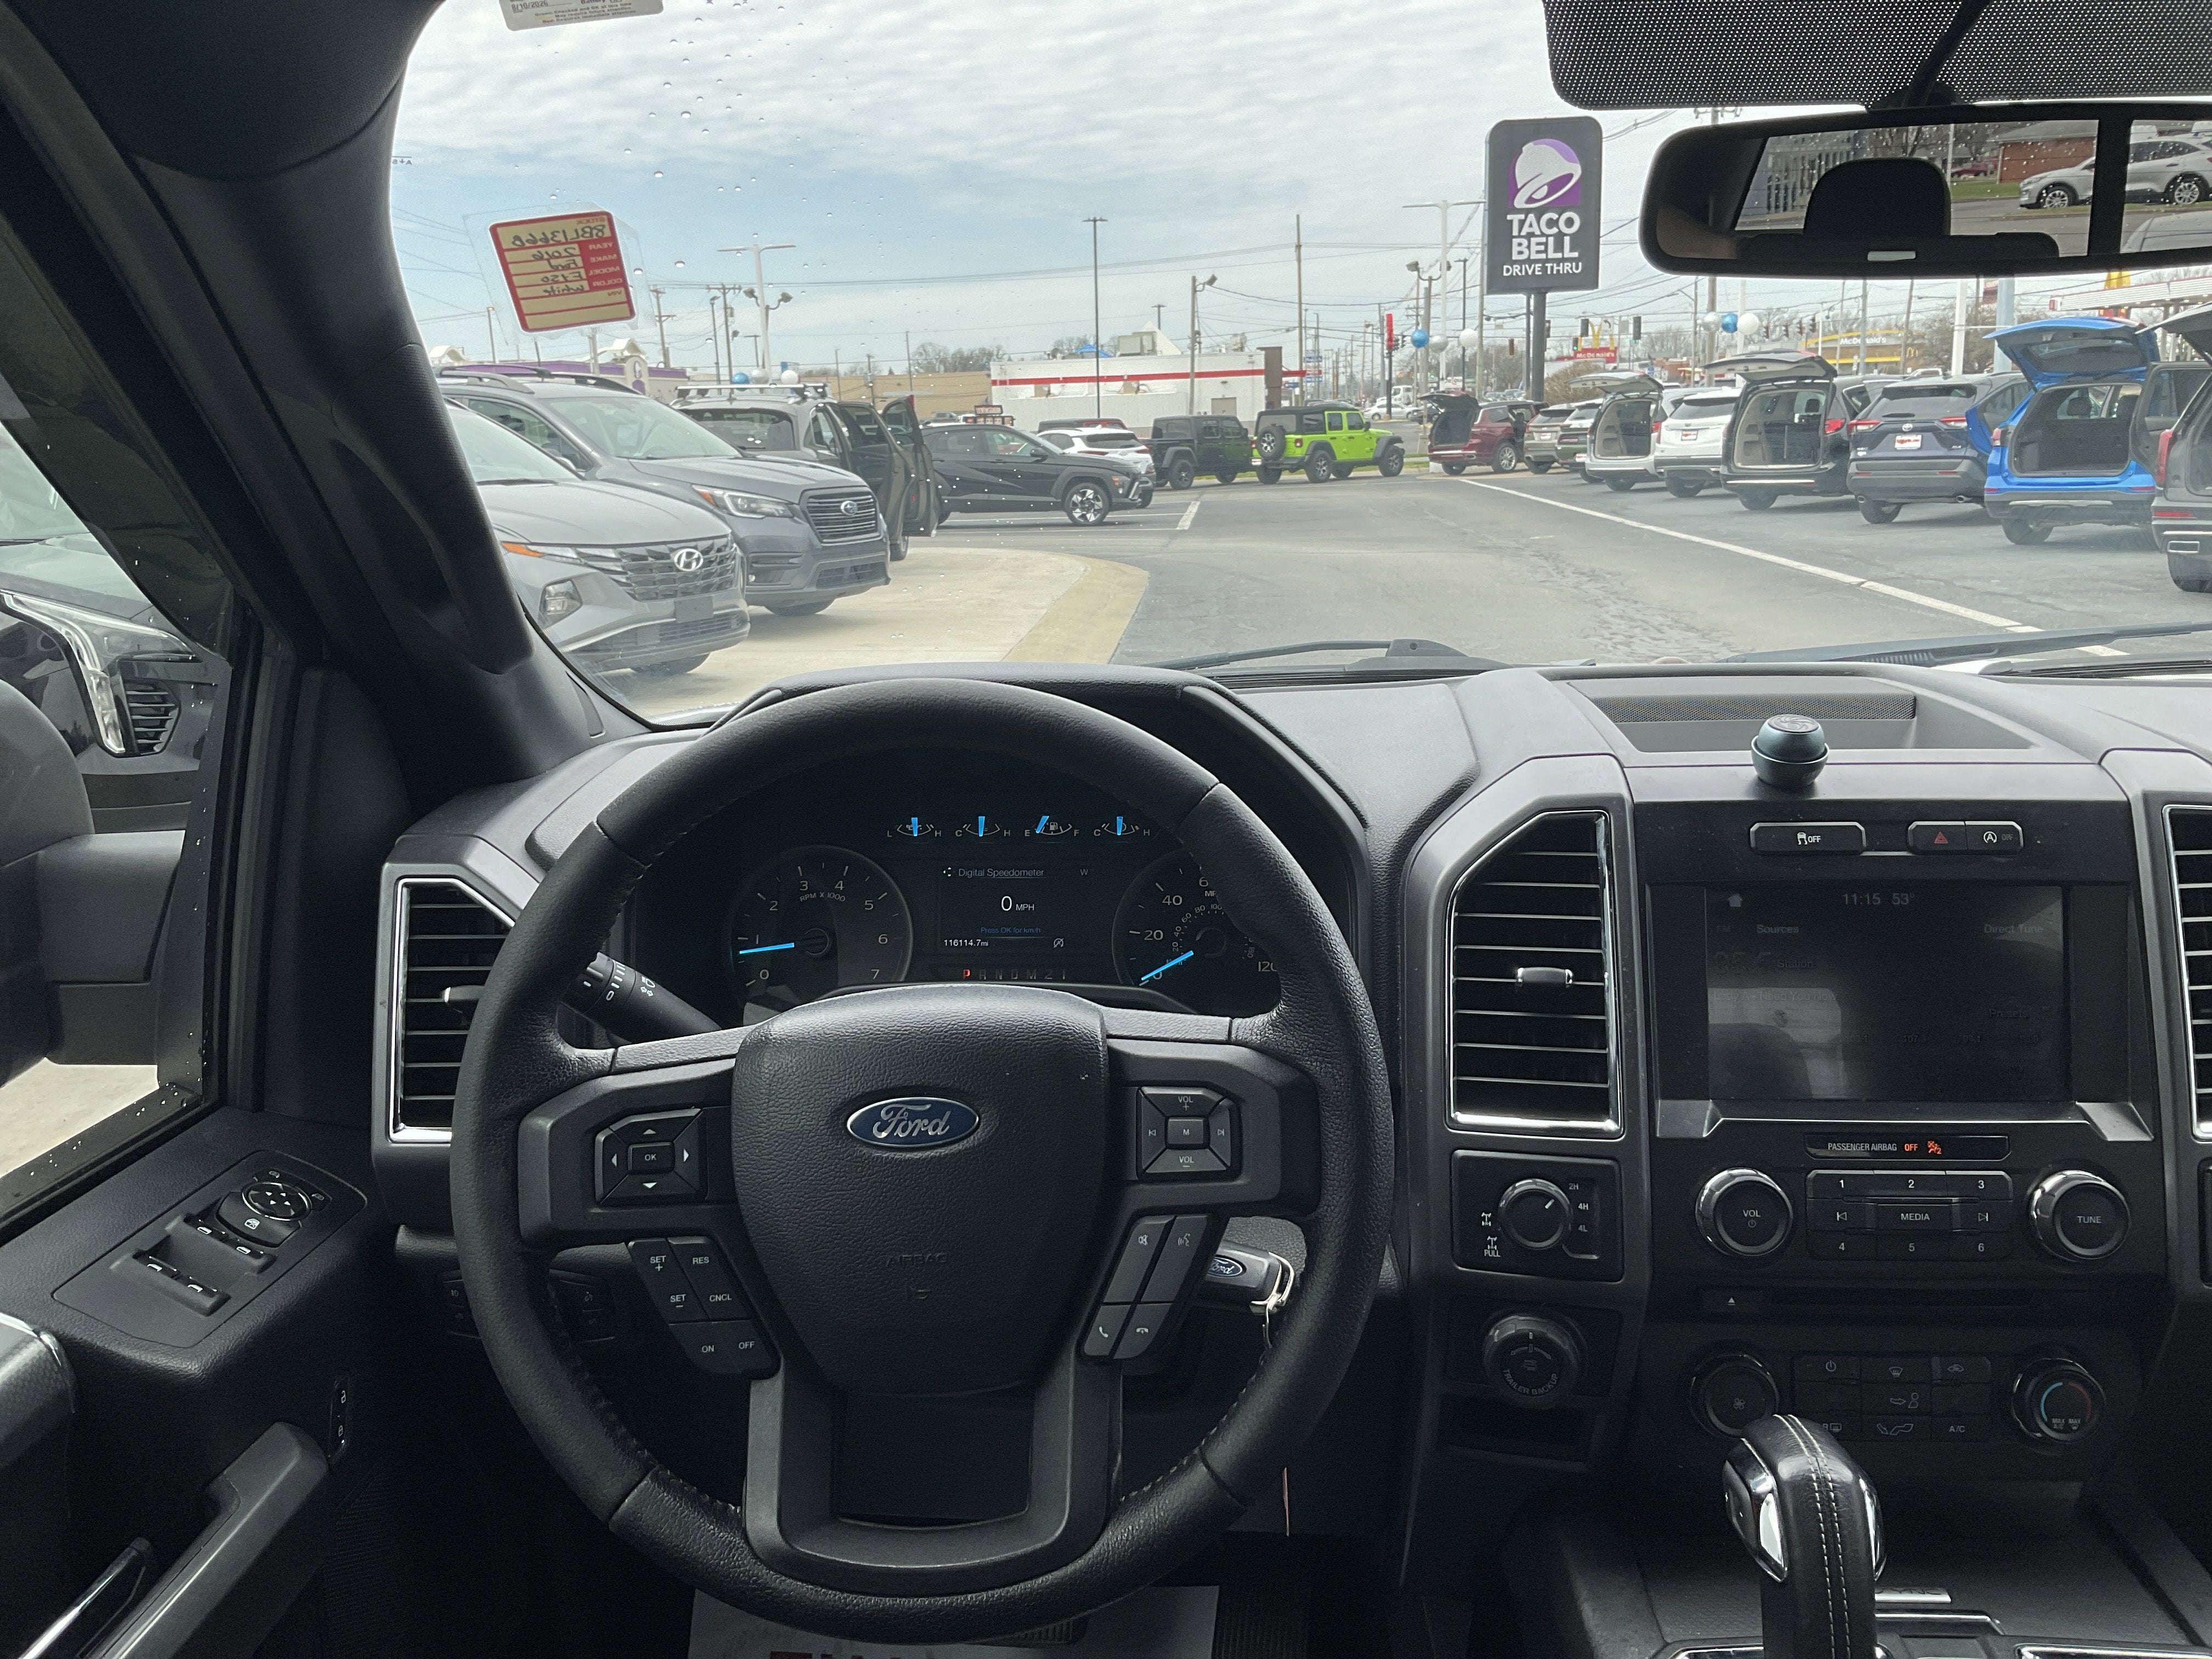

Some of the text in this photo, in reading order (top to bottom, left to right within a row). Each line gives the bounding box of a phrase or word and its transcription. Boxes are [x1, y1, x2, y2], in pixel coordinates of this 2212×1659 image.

[512, 1, 548, 10] 8/10/2026
[1506, 212, 1581, 236] TACO
[1512, 236, 1579, 261] BELL
[1503, 262, 1582, 276] DRIVE THRU
[1808, 835, 1821, 843] OFF
[958, 868, 1045, 878] Digital Speedometer
[799, 881, 809, 891] 3
[834, 881, 844, 890] 4
[799, 892, 817, 902] RPM
[827, 892, 846, 902] 1000
[1162, 895, 1183, 905] 40
[1841, 893, 1881, 905] 11:15
[769, 901, 778, 911] 2
[864, 900, 874, 910] 5
[1001, 895, 1012, 911] 0
[1194, 905, 1206, 913] 80
[1181, 912, 1192, 923] 60
[1756, 924, 1799, 934] Sources
[1984, 923, 2015, 933] Direct
[878, 934, 888, 944] 6
[1144, 930, 1164, 940] 20
[760, 969, 769, 979] 0
[871, 969, 879, 979] 7
[963, 969, 971, 980] P
[872, 1103, 952, 1139] Ford
[1828, 1143, 1918, 1152] PASSENGER AIRBAG OFF
[1839, 1180, 1844, 1188] 1
[1909, 1180, 1915, 1188] 2
[1978, 1180, 1985, 1189] 3
[1742, 1209, 1761, 1218] VOL
[1900, 1213, 1930, 1221] MEDIA
[2076, 1216, 2102, 1224] TUNE
[1838, 1242, 1845, 1251] 4
[1909, 1243, 1915, 1252] 5
[1978, 1243, 1985, 1252] 6
[1484, 1249, 1501, 1258] PULL
[650, 1255, 667, 1264] SET
[692, 1256, 709, 1265] RES
[670, 1294, 686, 1302] SET
[709, 1293, 732, 1302] CNCL
[702, 1345, 715, 1353] ON
[738, 1341, 755, 1350] OFF
[1531, 1373, 1559, 1395] BACKUP
